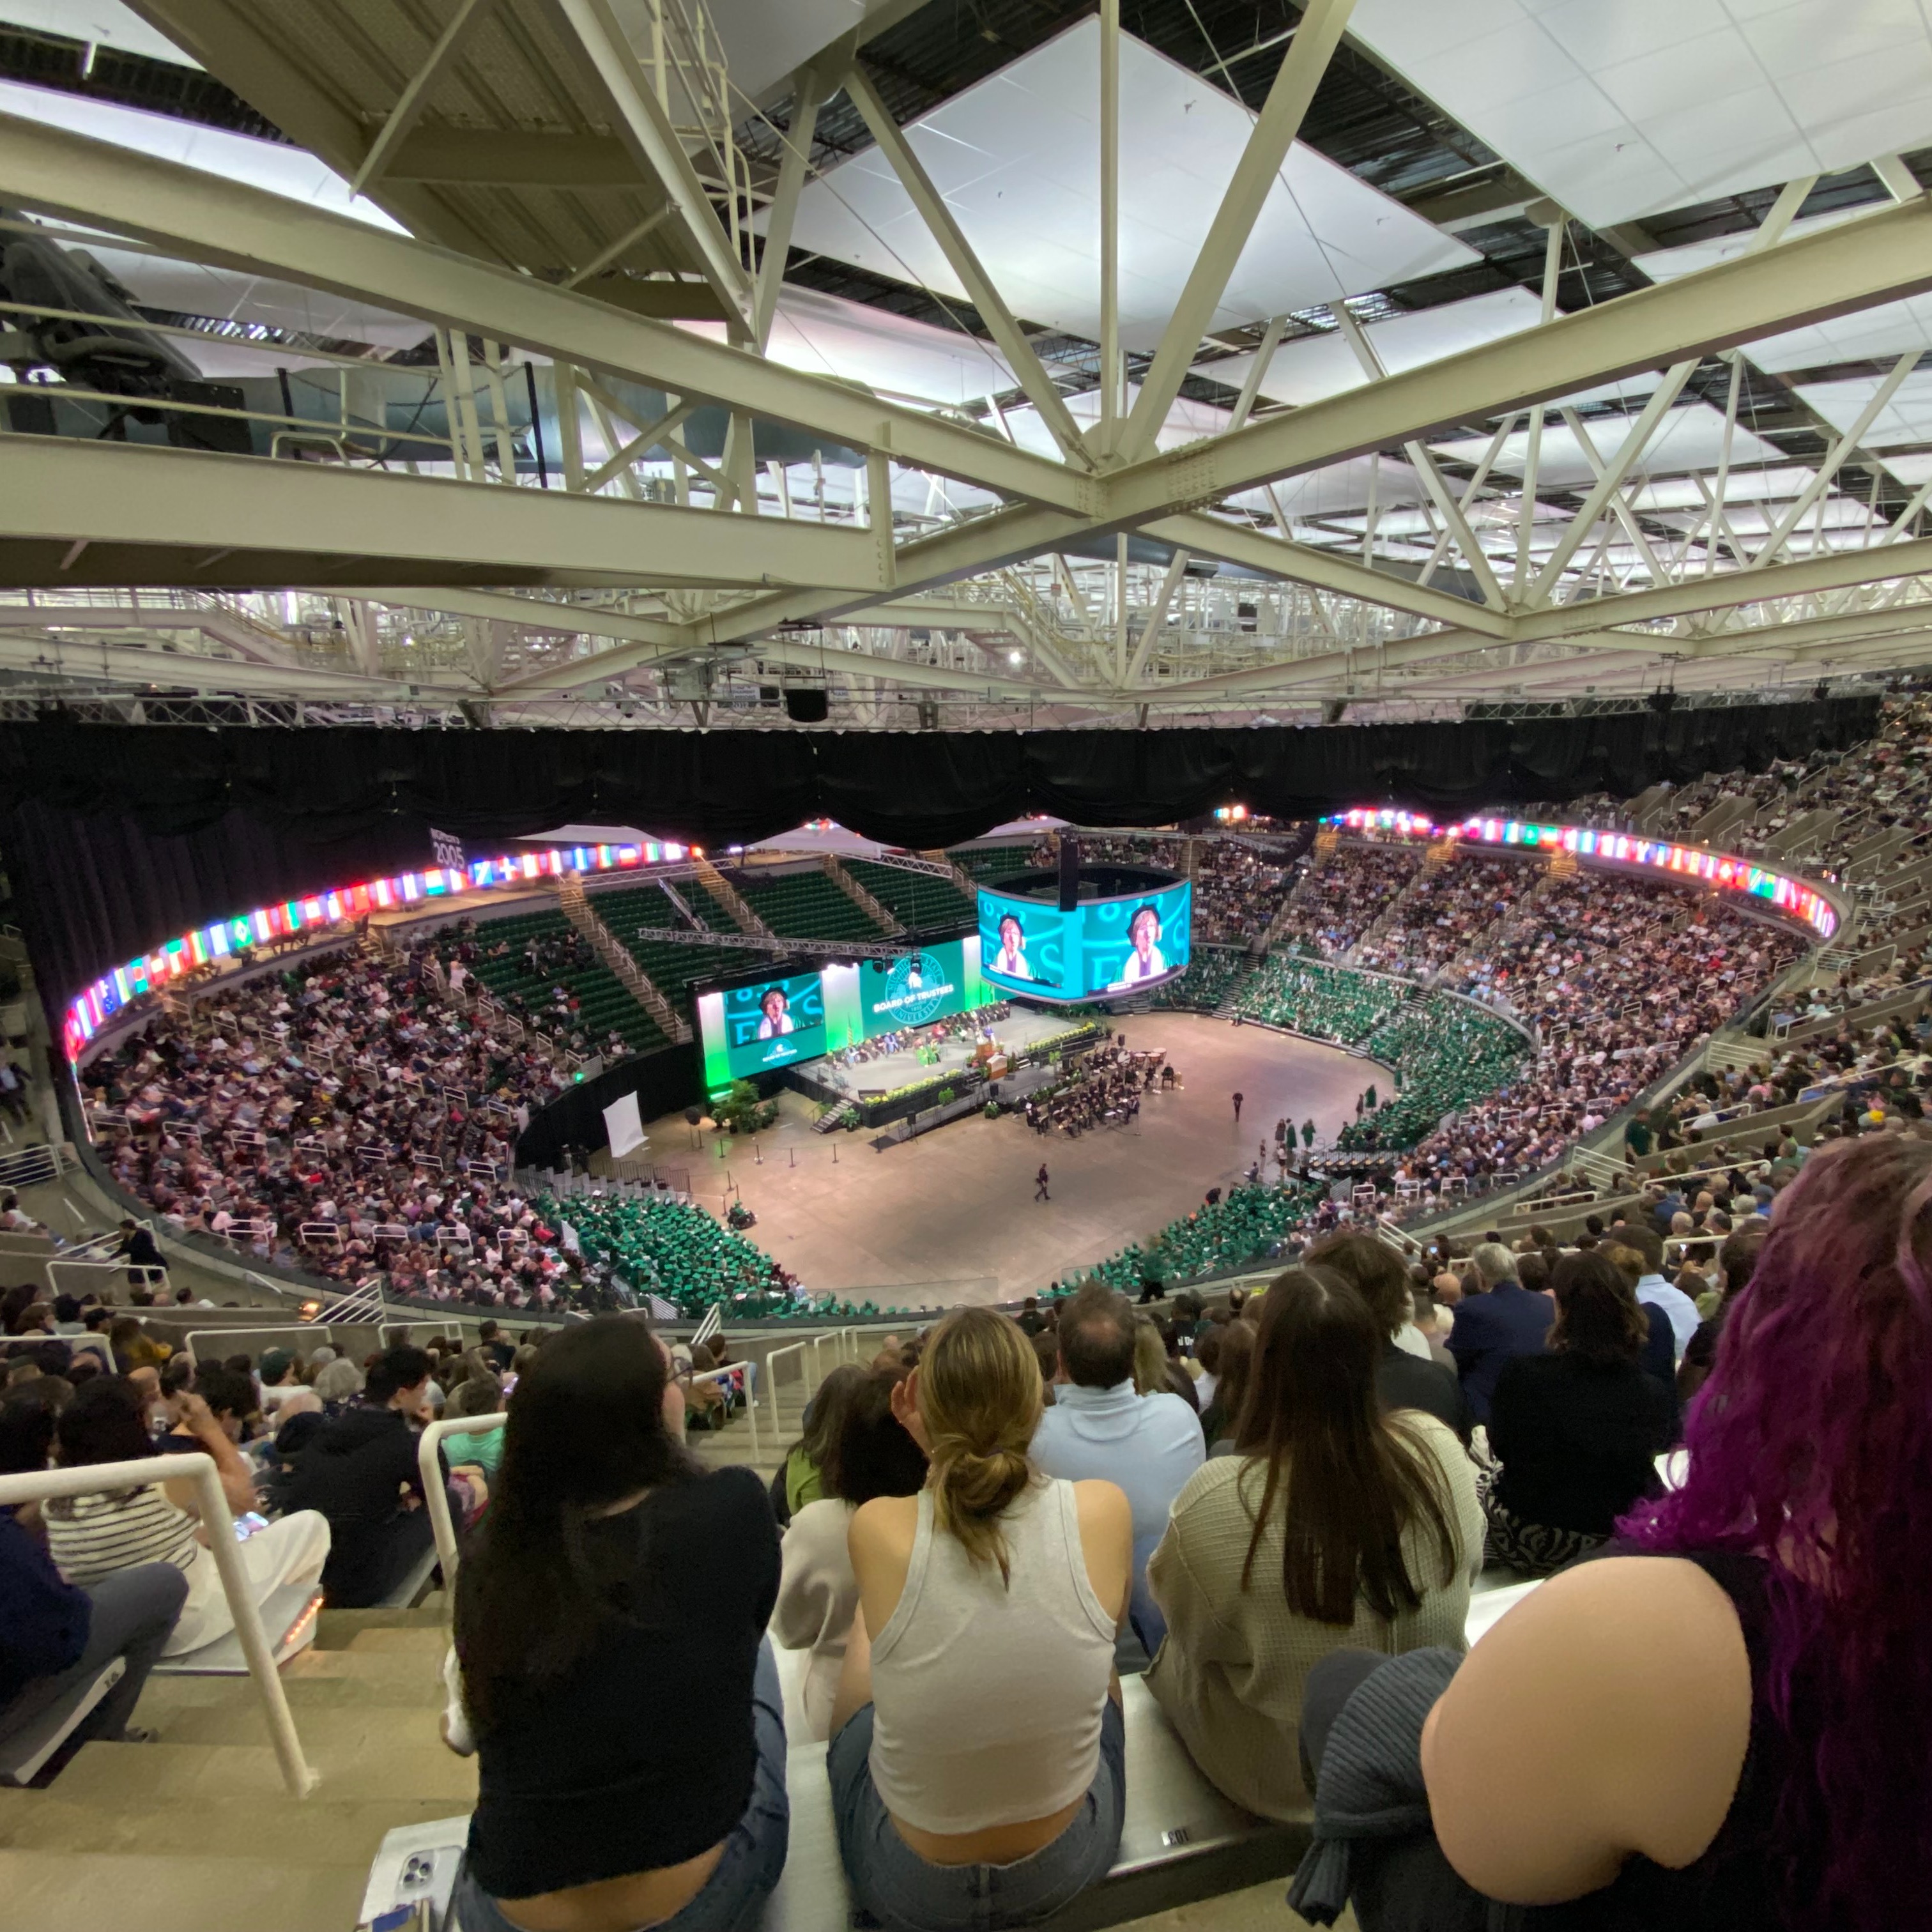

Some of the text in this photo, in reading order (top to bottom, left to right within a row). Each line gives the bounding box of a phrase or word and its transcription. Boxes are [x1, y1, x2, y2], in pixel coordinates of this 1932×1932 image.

[433, 841, 465, 869] 2005
[873, 984, 954, 1013] BOARD OF TRUSTEES
